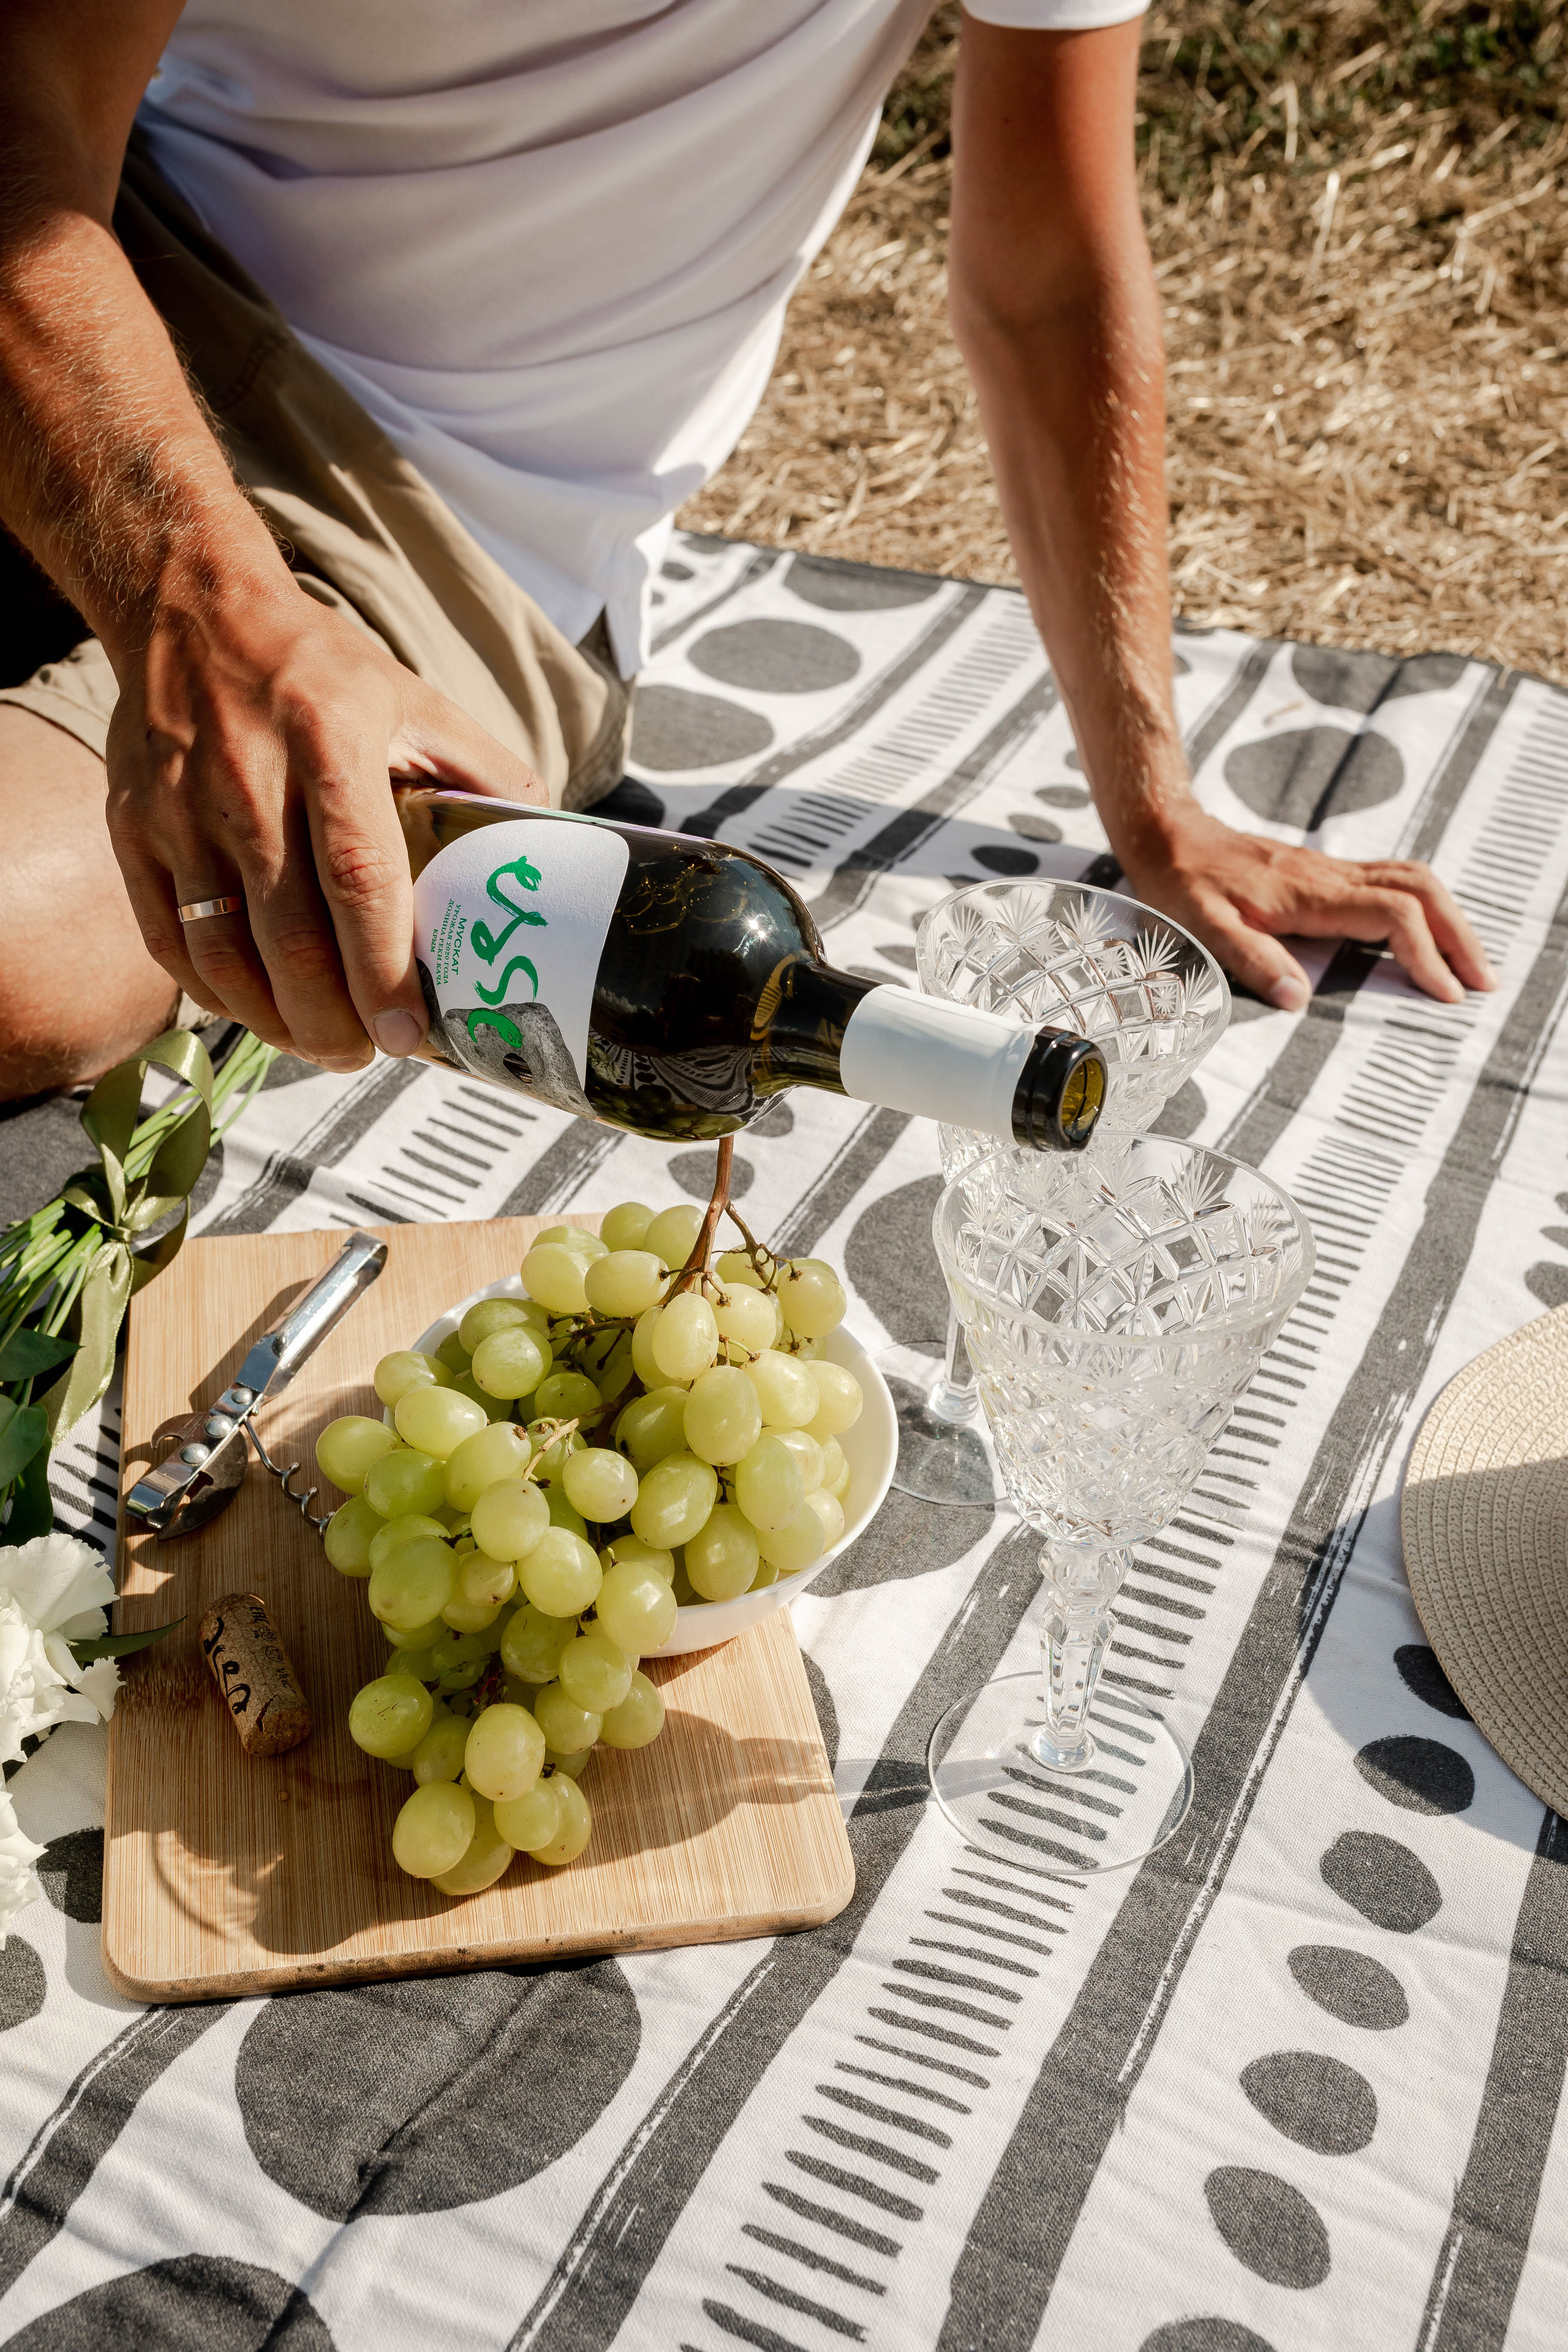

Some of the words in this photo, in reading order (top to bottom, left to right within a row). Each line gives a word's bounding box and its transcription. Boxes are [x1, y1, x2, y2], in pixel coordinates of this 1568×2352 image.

[440, 899, 454, 935] ДОЛИНА
[447, 904, 461, 940] УРОЖАЯ
[451, 918, 467, 975] МУСКАТ
